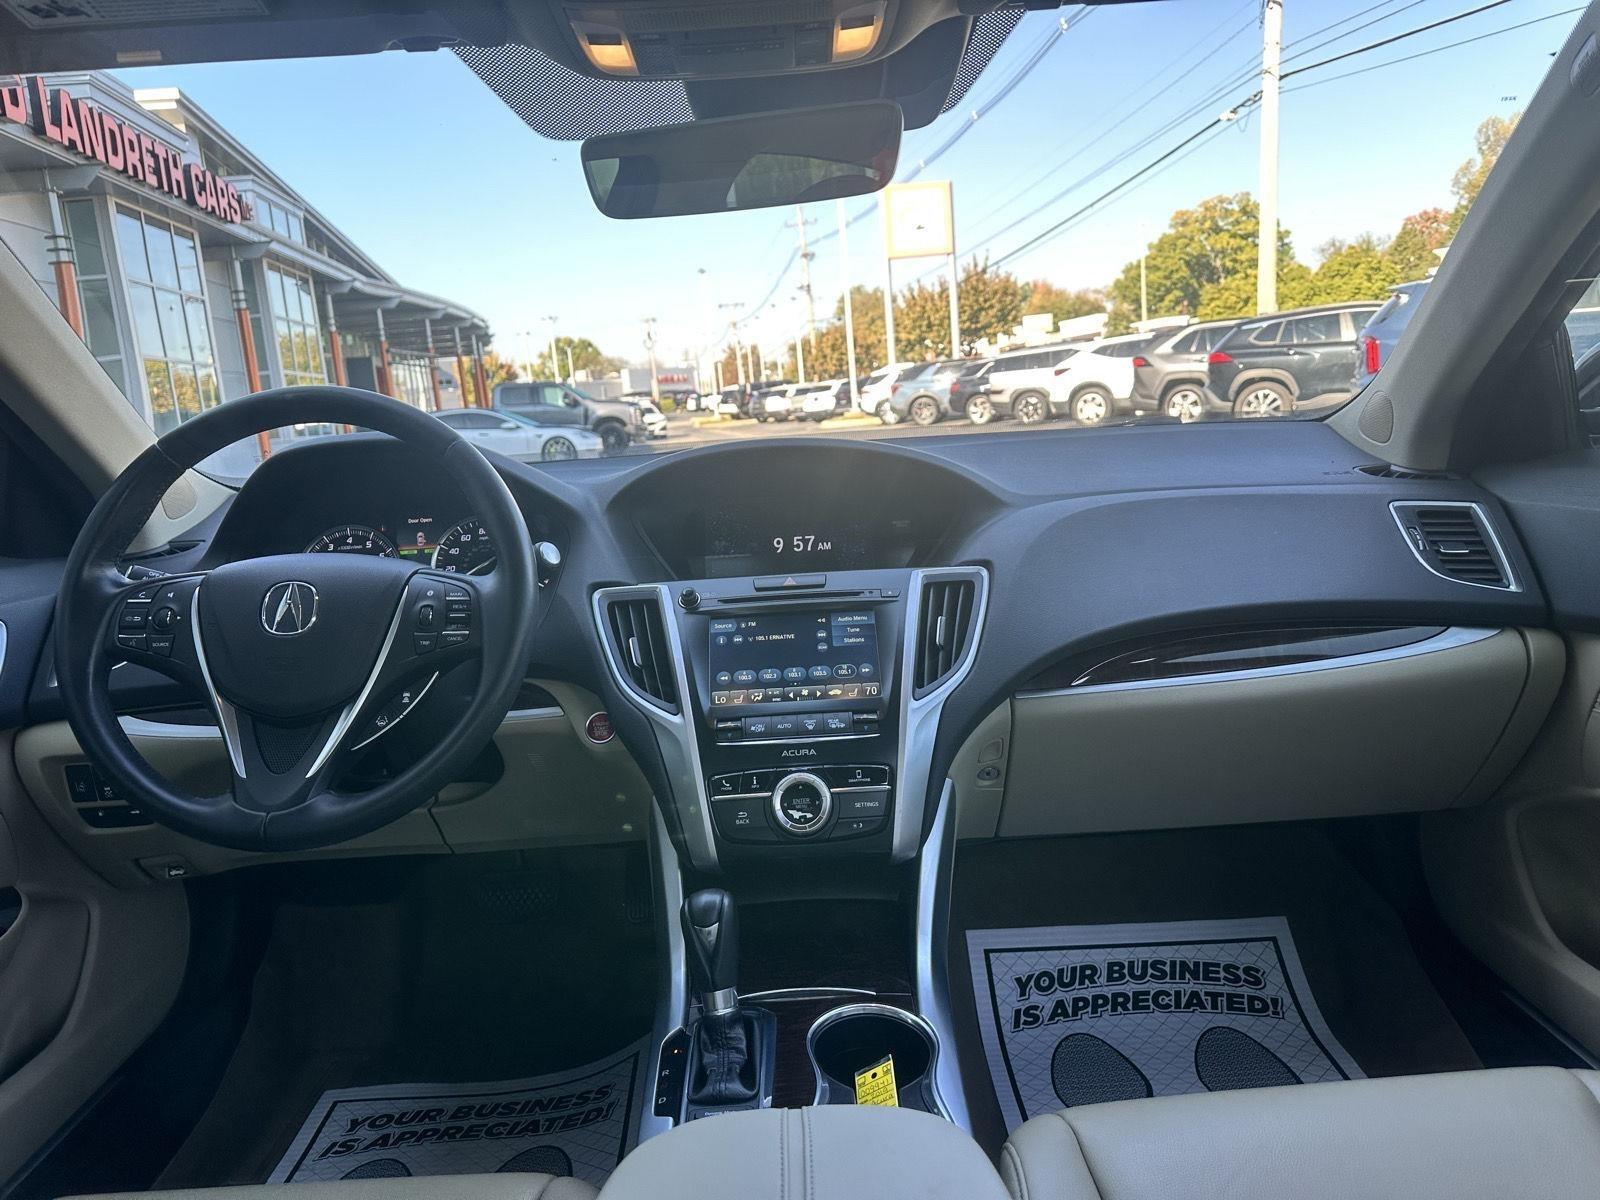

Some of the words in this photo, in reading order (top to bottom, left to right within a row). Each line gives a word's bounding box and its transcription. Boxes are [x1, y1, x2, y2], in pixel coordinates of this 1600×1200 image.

[35, 76, 187, 200] LANDRETH
[190, 163, 241, 224] CARS
[346, 536, 353, 544] 4
[460, 534, 471, 542] 60
[327, 543, 334, 551] 3
[773, 537, 784, 553] 9
[793, 535, 815, 552] 57
[817, 541, 832, 551] AM
[449, 547, 460, 555] 40
[838, 614, 853, 622] Audio
[714, 622, 732, 630] Source
[844, 636, 865, 644] Stations
[865, 686, 878, 695] 70
[715, 695, 726, 704] Lo
[781, 748, 817, 757] ACURA
[1013, 962, 1101, 1000] YOUR
[1105, 958, 1267, 989] BUSINESS
[1011, 1003, 1045, 1032] IS
[1047, 988, 1284, 1023] APPRECIATED!
[661, 1069, 670, 1077] R
[658, 1096, 667, 1104] D
[346, 1106, 442, 1135] YOUR
[447, 1082, 616, 1122] BUSINESS
[312, 1136, 360, 1162] IS
[361, 1099, 620, 1151] APPRECIATED!
